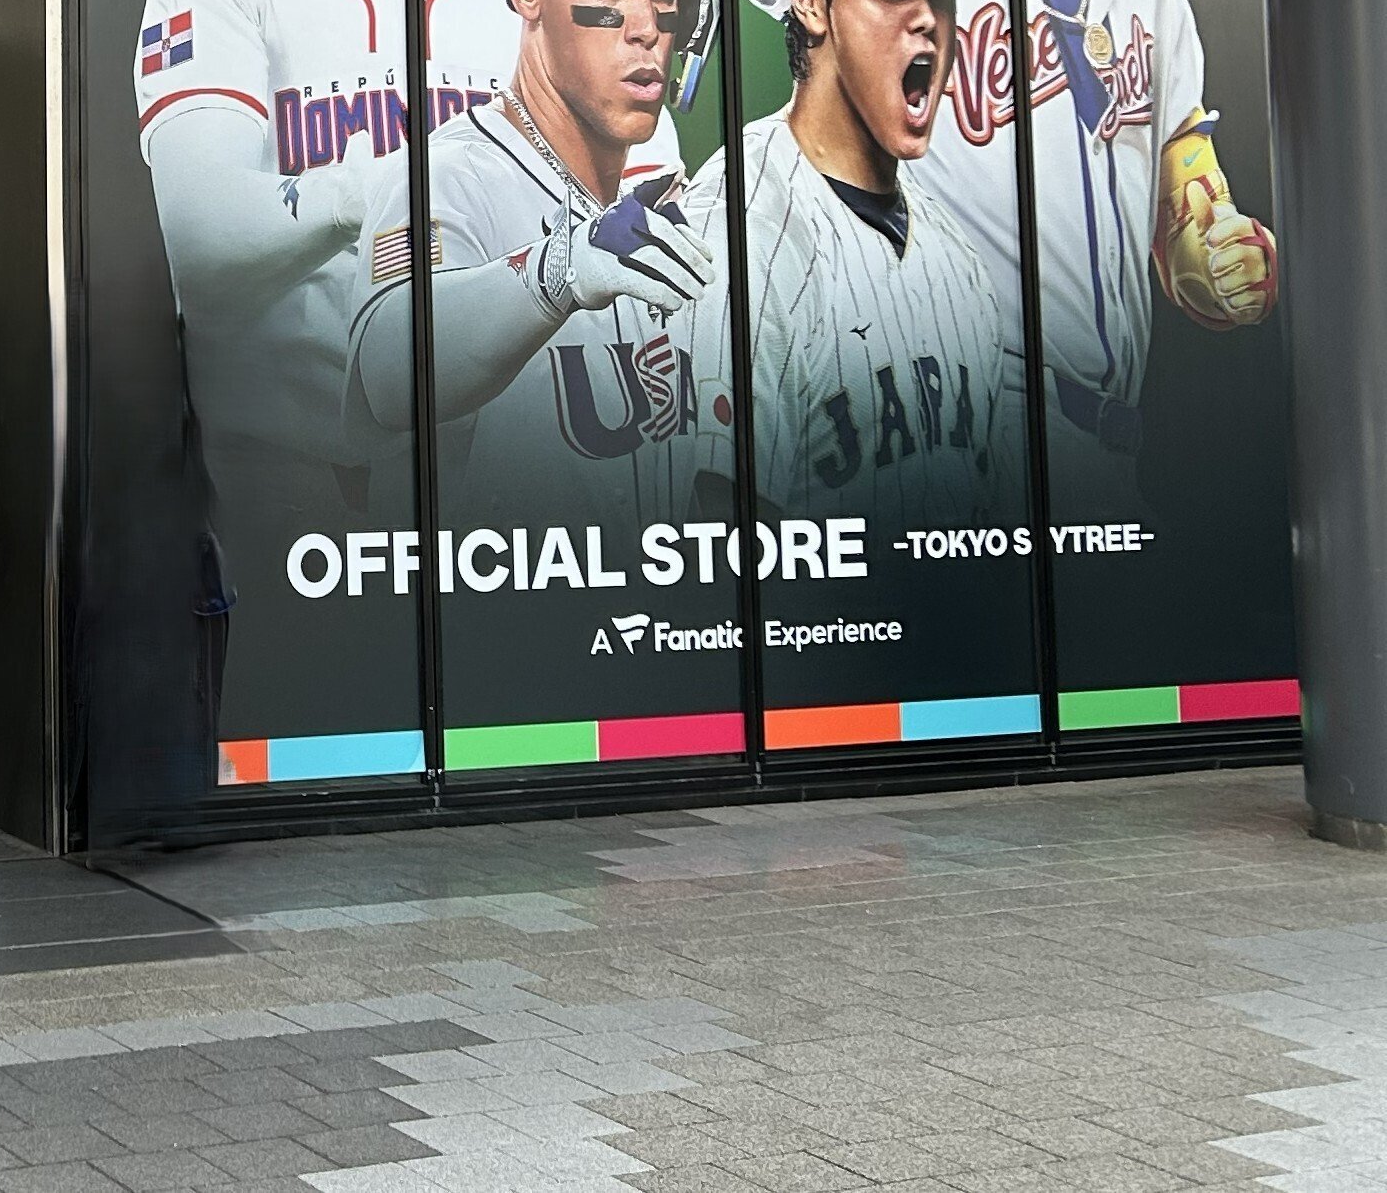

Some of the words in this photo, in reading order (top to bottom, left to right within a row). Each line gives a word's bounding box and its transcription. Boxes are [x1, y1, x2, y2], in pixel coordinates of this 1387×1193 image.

[812, 354, 988, 489] JAPA
[286, 525, 627, 599] OFFICIAL
[640, 517, 868, 588] STORE
[1013, 523, 1155, 557] SYTREE-
[590, 628, 614, 656] A
[654, 618, 744, 653] Fanatic
[765, 618, 903, 653] Experience
